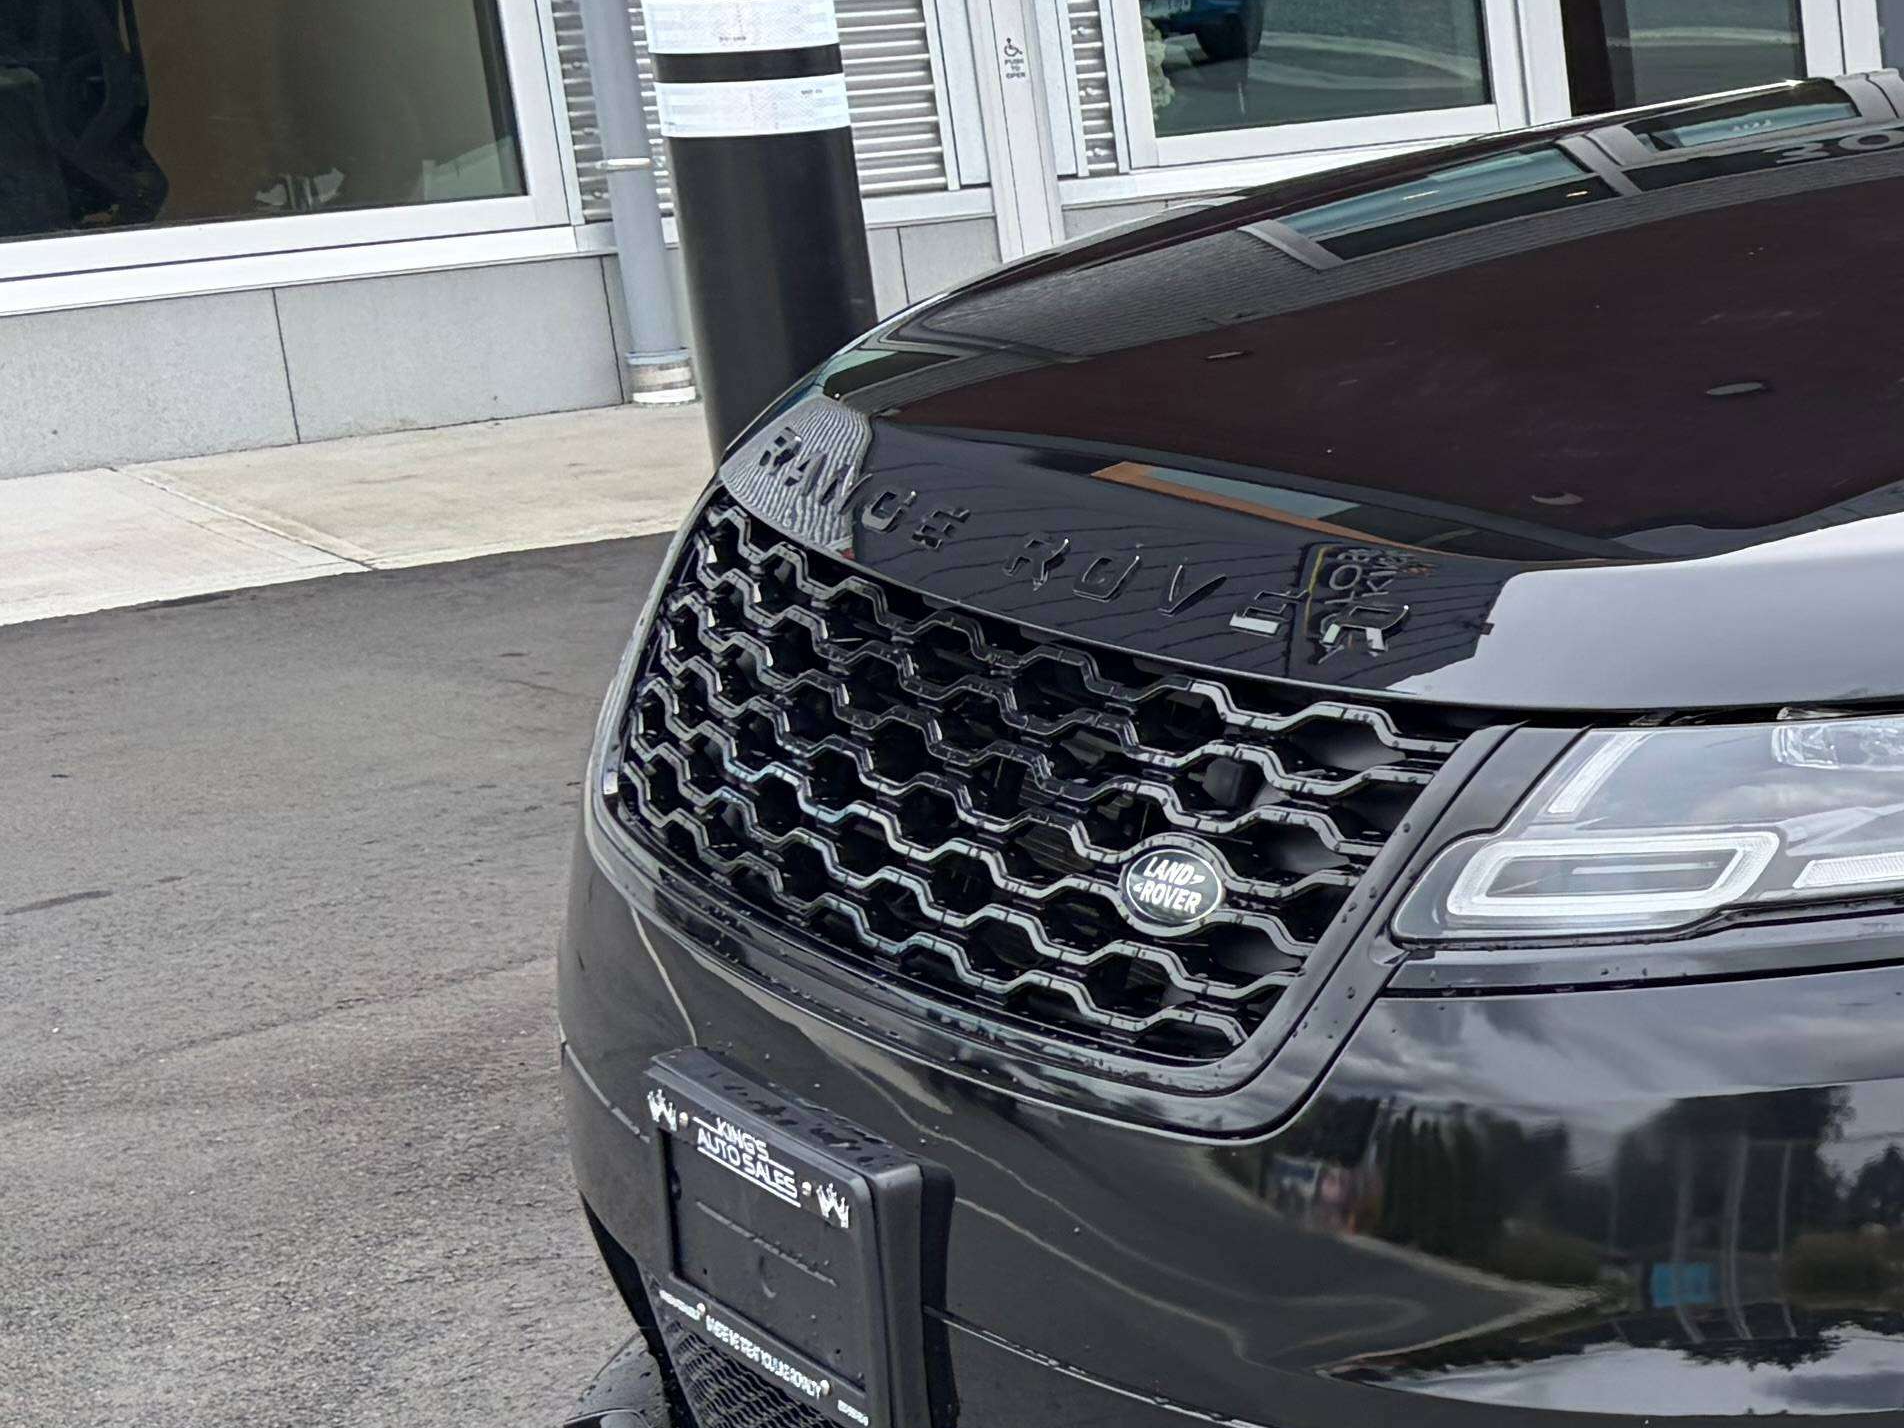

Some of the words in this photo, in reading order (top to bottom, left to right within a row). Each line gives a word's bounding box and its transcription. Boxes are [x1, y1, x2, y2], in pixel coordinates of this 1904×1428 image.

[759, 426, 971, 551] RANGE
[1003, 531, 1410, 654] ROVER
[1139, 880, 1202, 914] ROVER
[1143, 856, 1195, 886] LAND
[697, 1128, 741, 1166] AUTO
[742, 1153, 798, 1199] SALES
